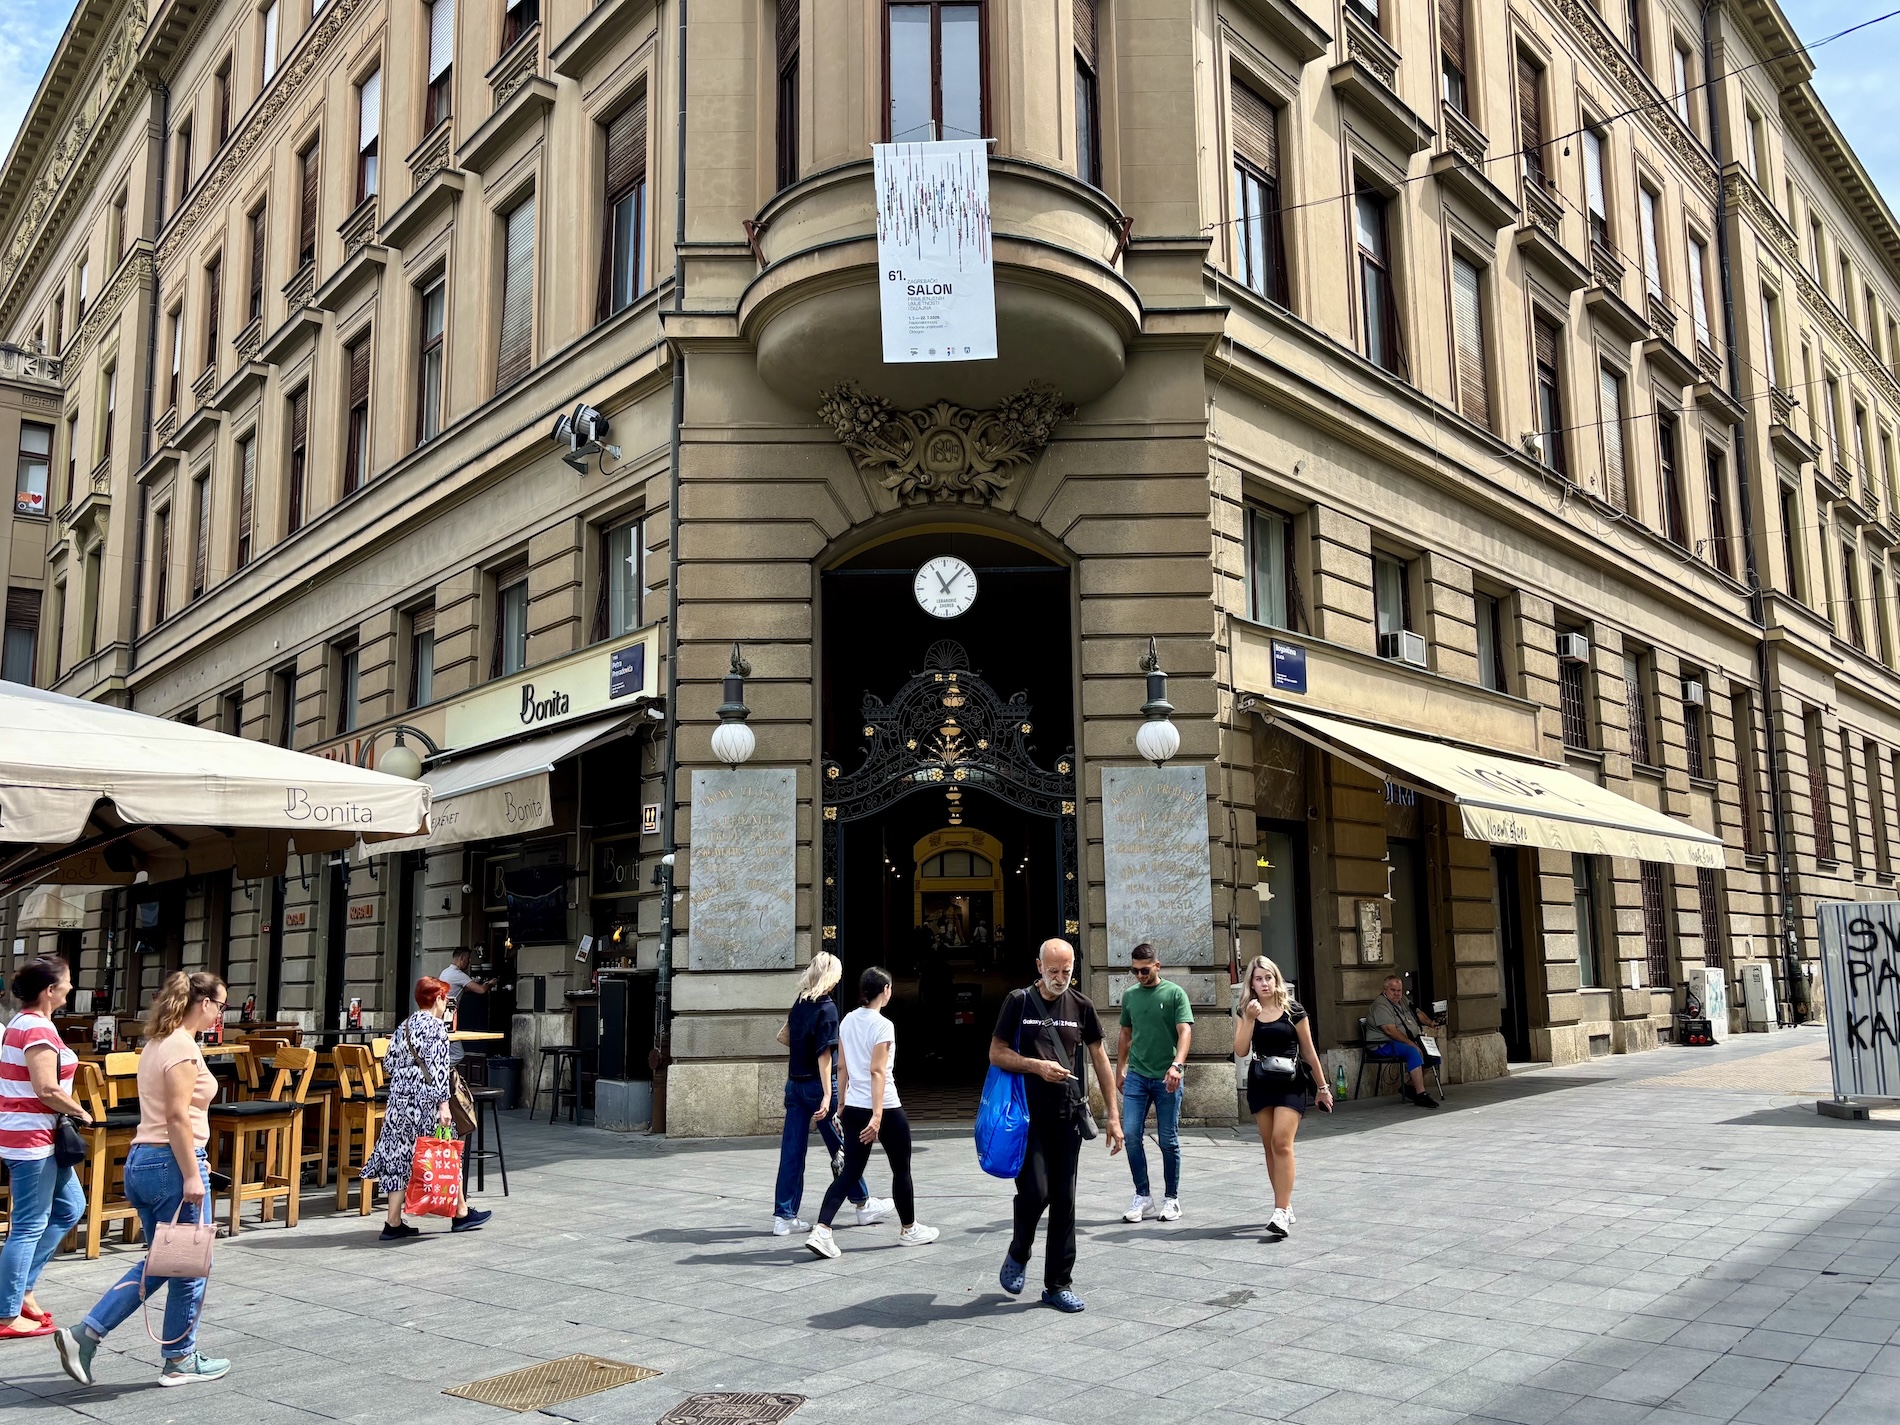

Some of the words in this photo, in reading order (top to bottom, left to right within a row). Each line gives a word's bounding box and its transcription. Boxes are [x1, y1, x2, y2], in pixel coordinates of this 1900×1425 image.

[888, 270, 906, 281] 61.
[907, 284, 952, 295] SALON
[520, 684, 569, 724] Bonita
[284, 787, 373, 824] Bonita
[504, 792, 543, 823] Bonita
[603, 847, 639, 883] Bonit
